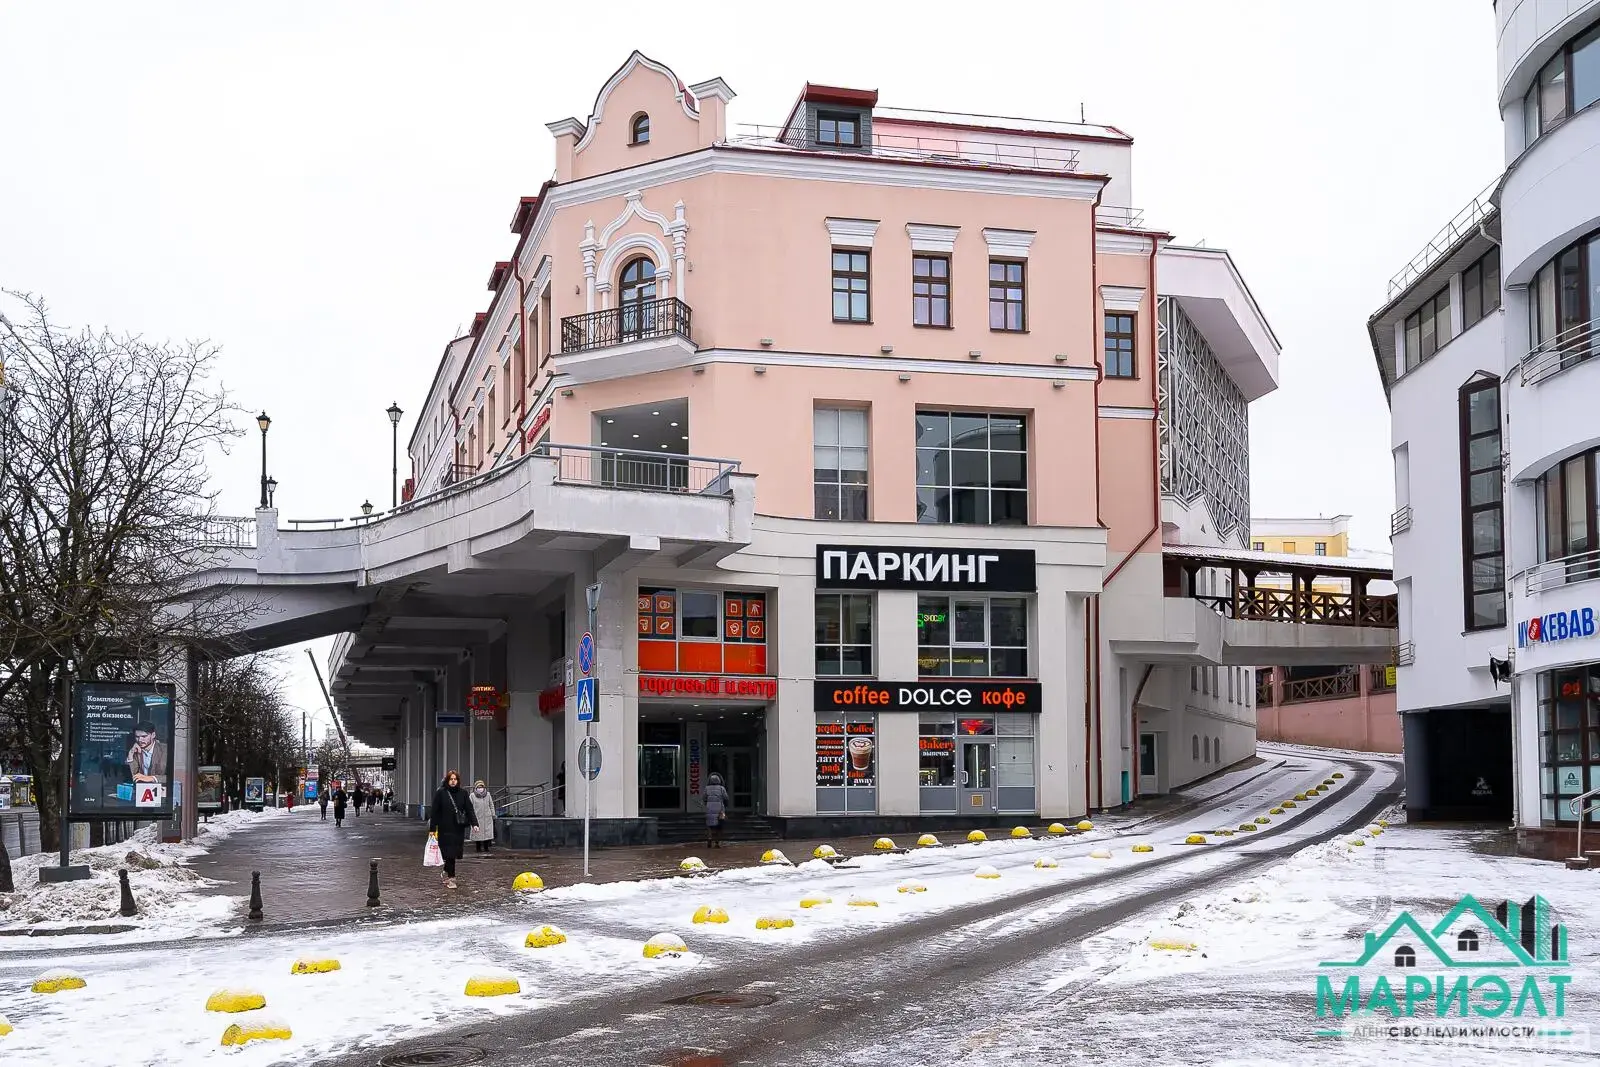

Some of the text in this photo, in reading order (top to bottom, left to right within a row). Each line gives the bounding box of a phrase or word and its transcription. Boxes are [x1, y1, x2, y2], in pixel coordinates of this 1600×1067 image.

[823, 550, 999, 583] ПАРКИНГ
[1517, 620, 1528, 649] MY
[1540, 607, 1595, 643] KEBAB
[639, 676, 776, 698] торговый центр
[87, 695, 124, 703] Комплекс
[833, 685, 890, 705] coffee
[982, 688, 1026, 709] кофе
[101, 711, 134, 719] бизнеса.
[846, 723, 875, 733] Coffee
[919, 740, 954, 751] Bakery
[821, 763, 840, 774] раф
[141, 787, 158, 802] A1
